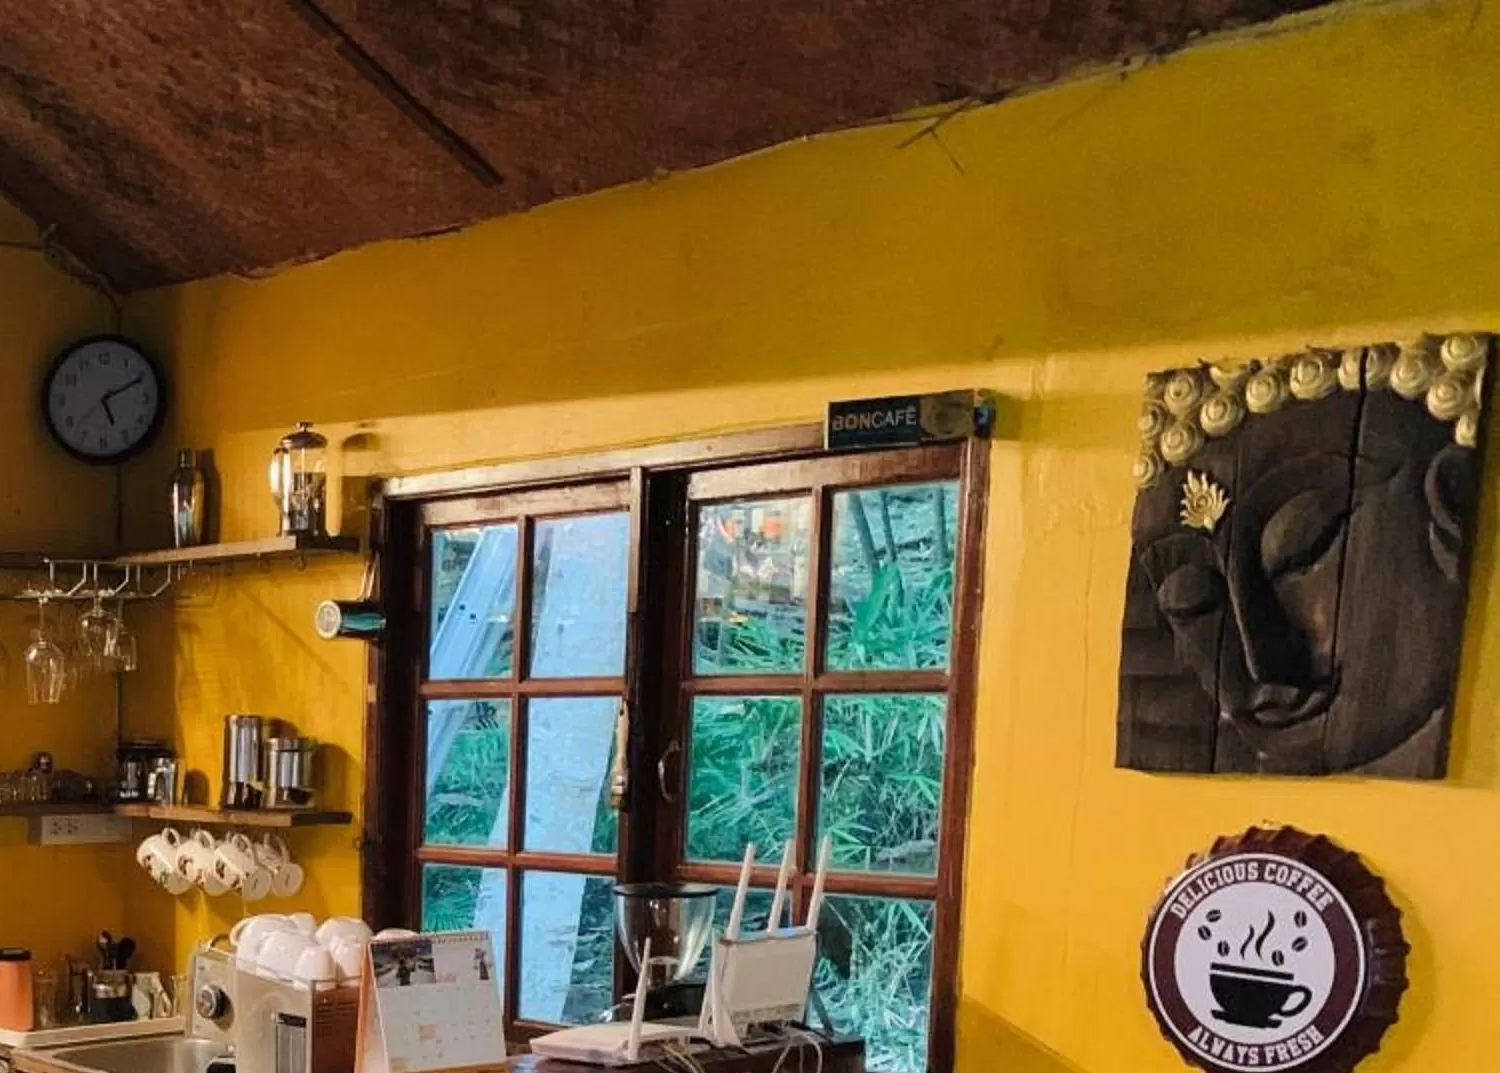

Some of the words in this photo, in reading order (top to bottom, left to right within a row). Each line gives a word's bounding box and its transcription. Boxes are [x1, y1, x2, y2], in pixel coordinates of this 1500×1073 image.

[1171, 862, 1259, 919] DELICIOUS
[1264, 863, 1334, 912] COFFEE
[1188, 1027, 1259, 1065] ALWAYS
[1264, 1025, 1325, 1065] FRESH
